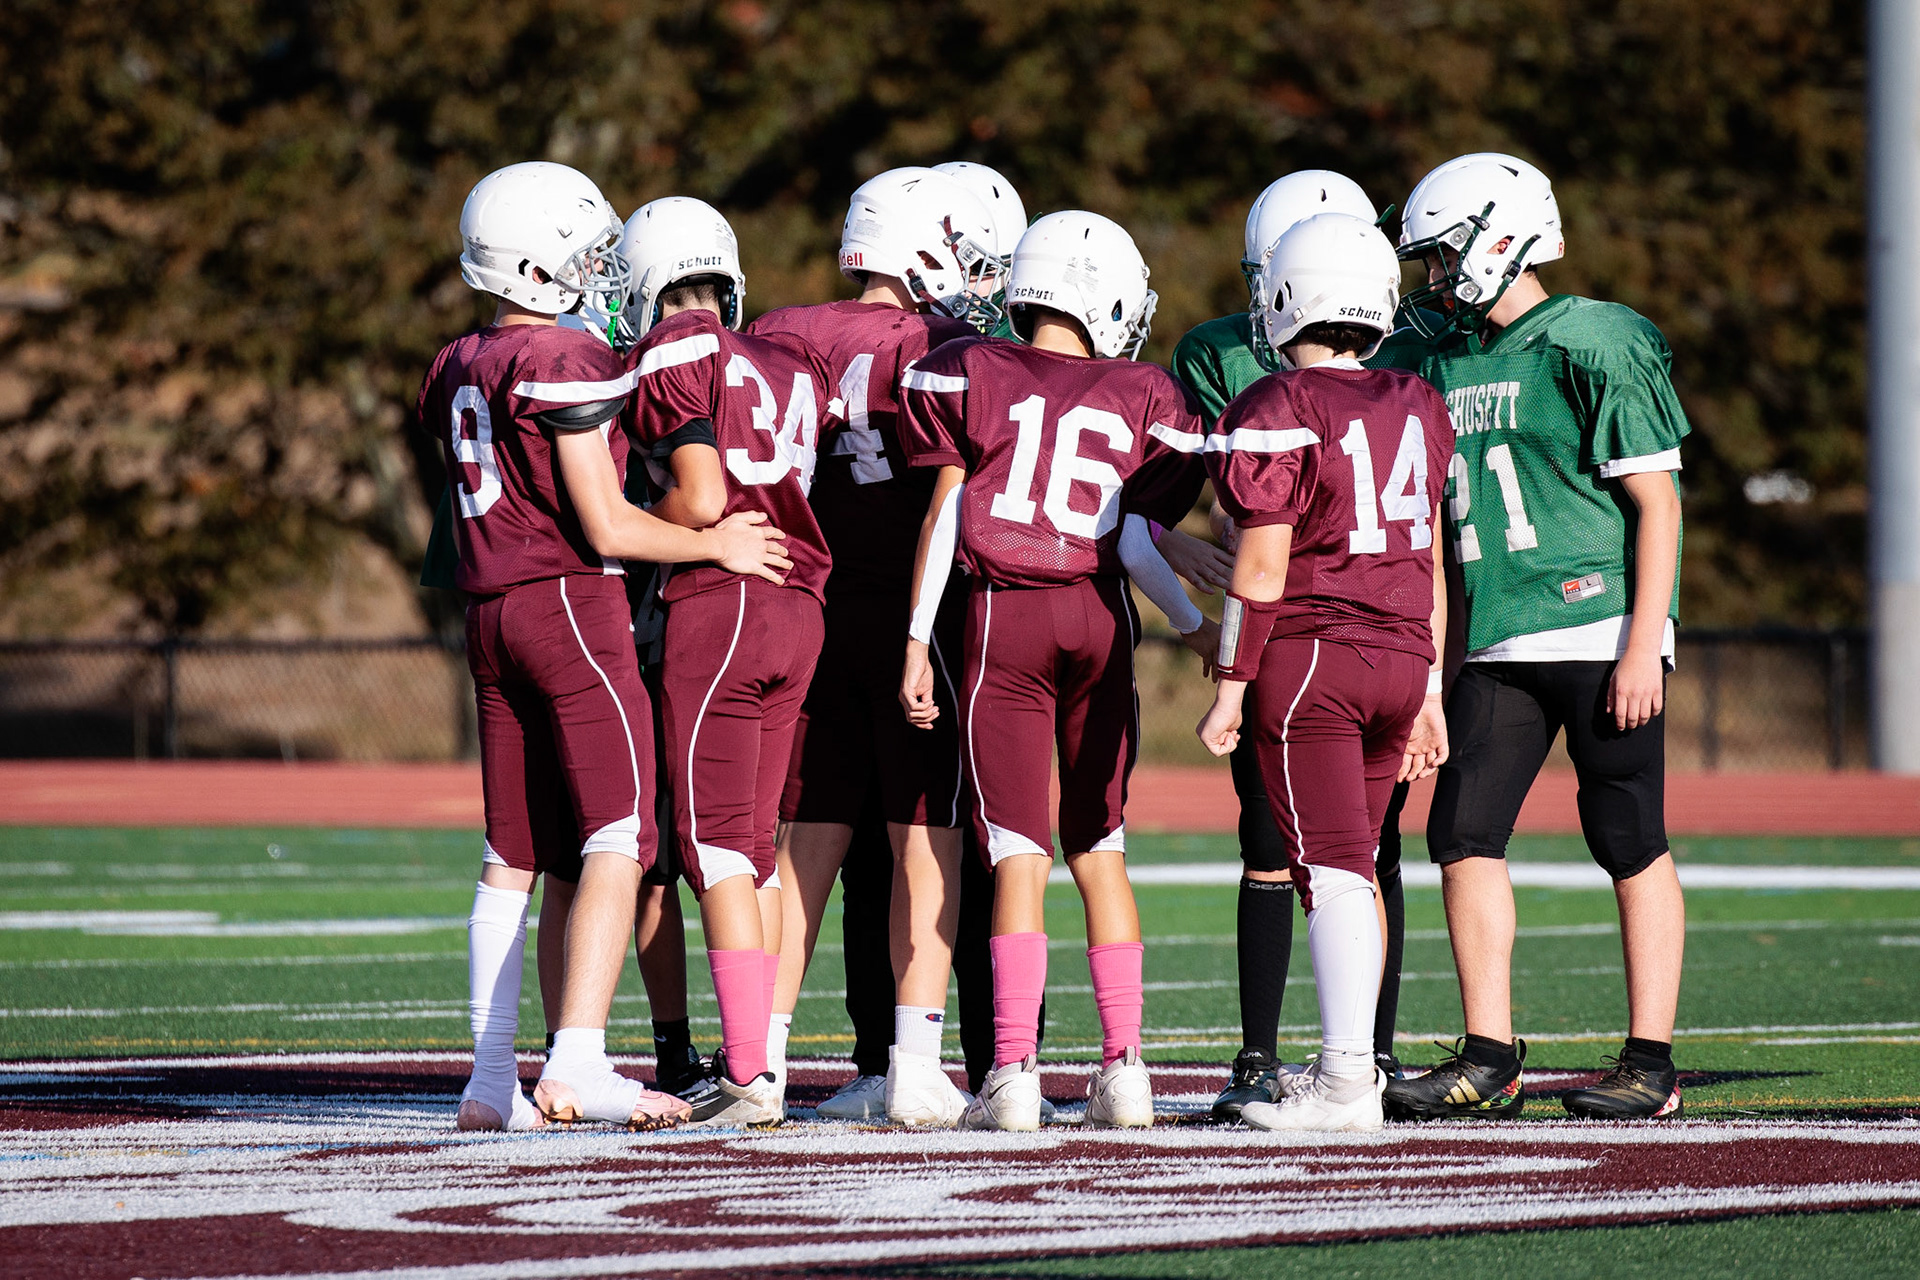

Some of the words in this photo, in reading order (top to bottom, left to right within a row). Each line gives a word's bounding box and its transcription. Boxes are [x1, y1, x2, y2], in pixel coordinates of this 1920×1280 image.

[1338, 306, 1382, 321] schutt
[451, 385, 502, 518] 9
[725, 353, 817, 499] 34
[829, 353, 894, 485] 4
[990, 394, 1135, 540] 16
[1339, 414, 1434, 554] 14
[1443, 443, 1538, 565] 21
